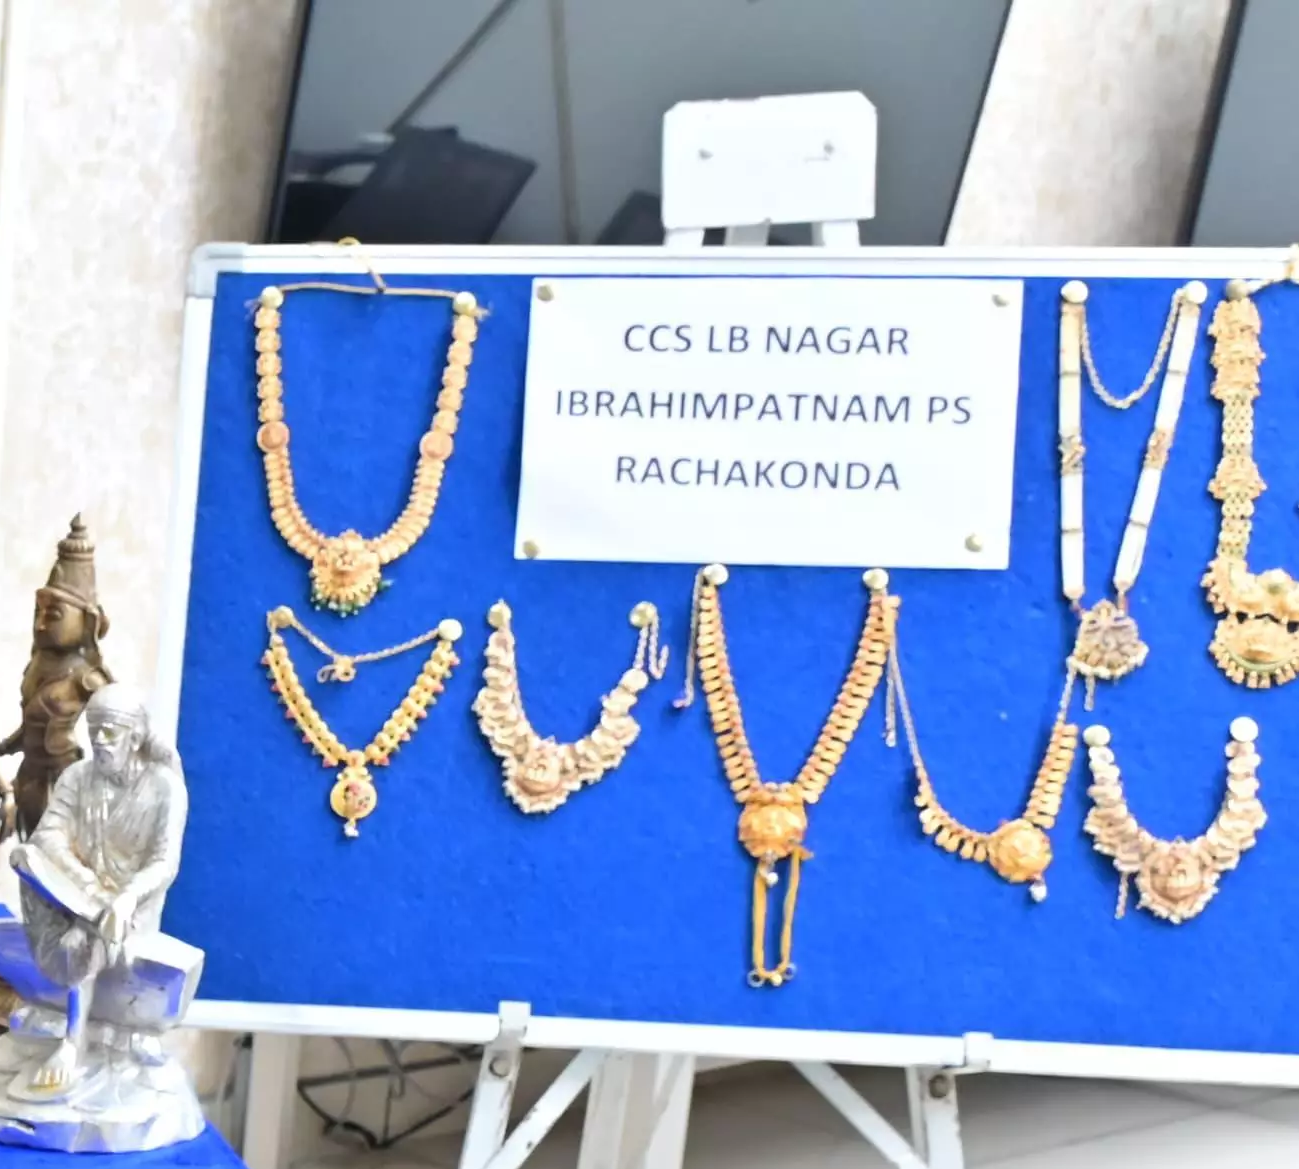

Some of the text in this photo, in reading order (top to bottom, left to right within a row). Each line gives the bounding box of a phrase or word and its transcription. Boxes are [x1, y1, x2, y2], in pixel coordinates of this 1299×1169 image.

[623, 324, 910, 356] CCS LB NAGAR
[555, 390, 973, 425] IBRAHIMPATNAM PS
[615, 456, 901, 491] RACHAKONDA
